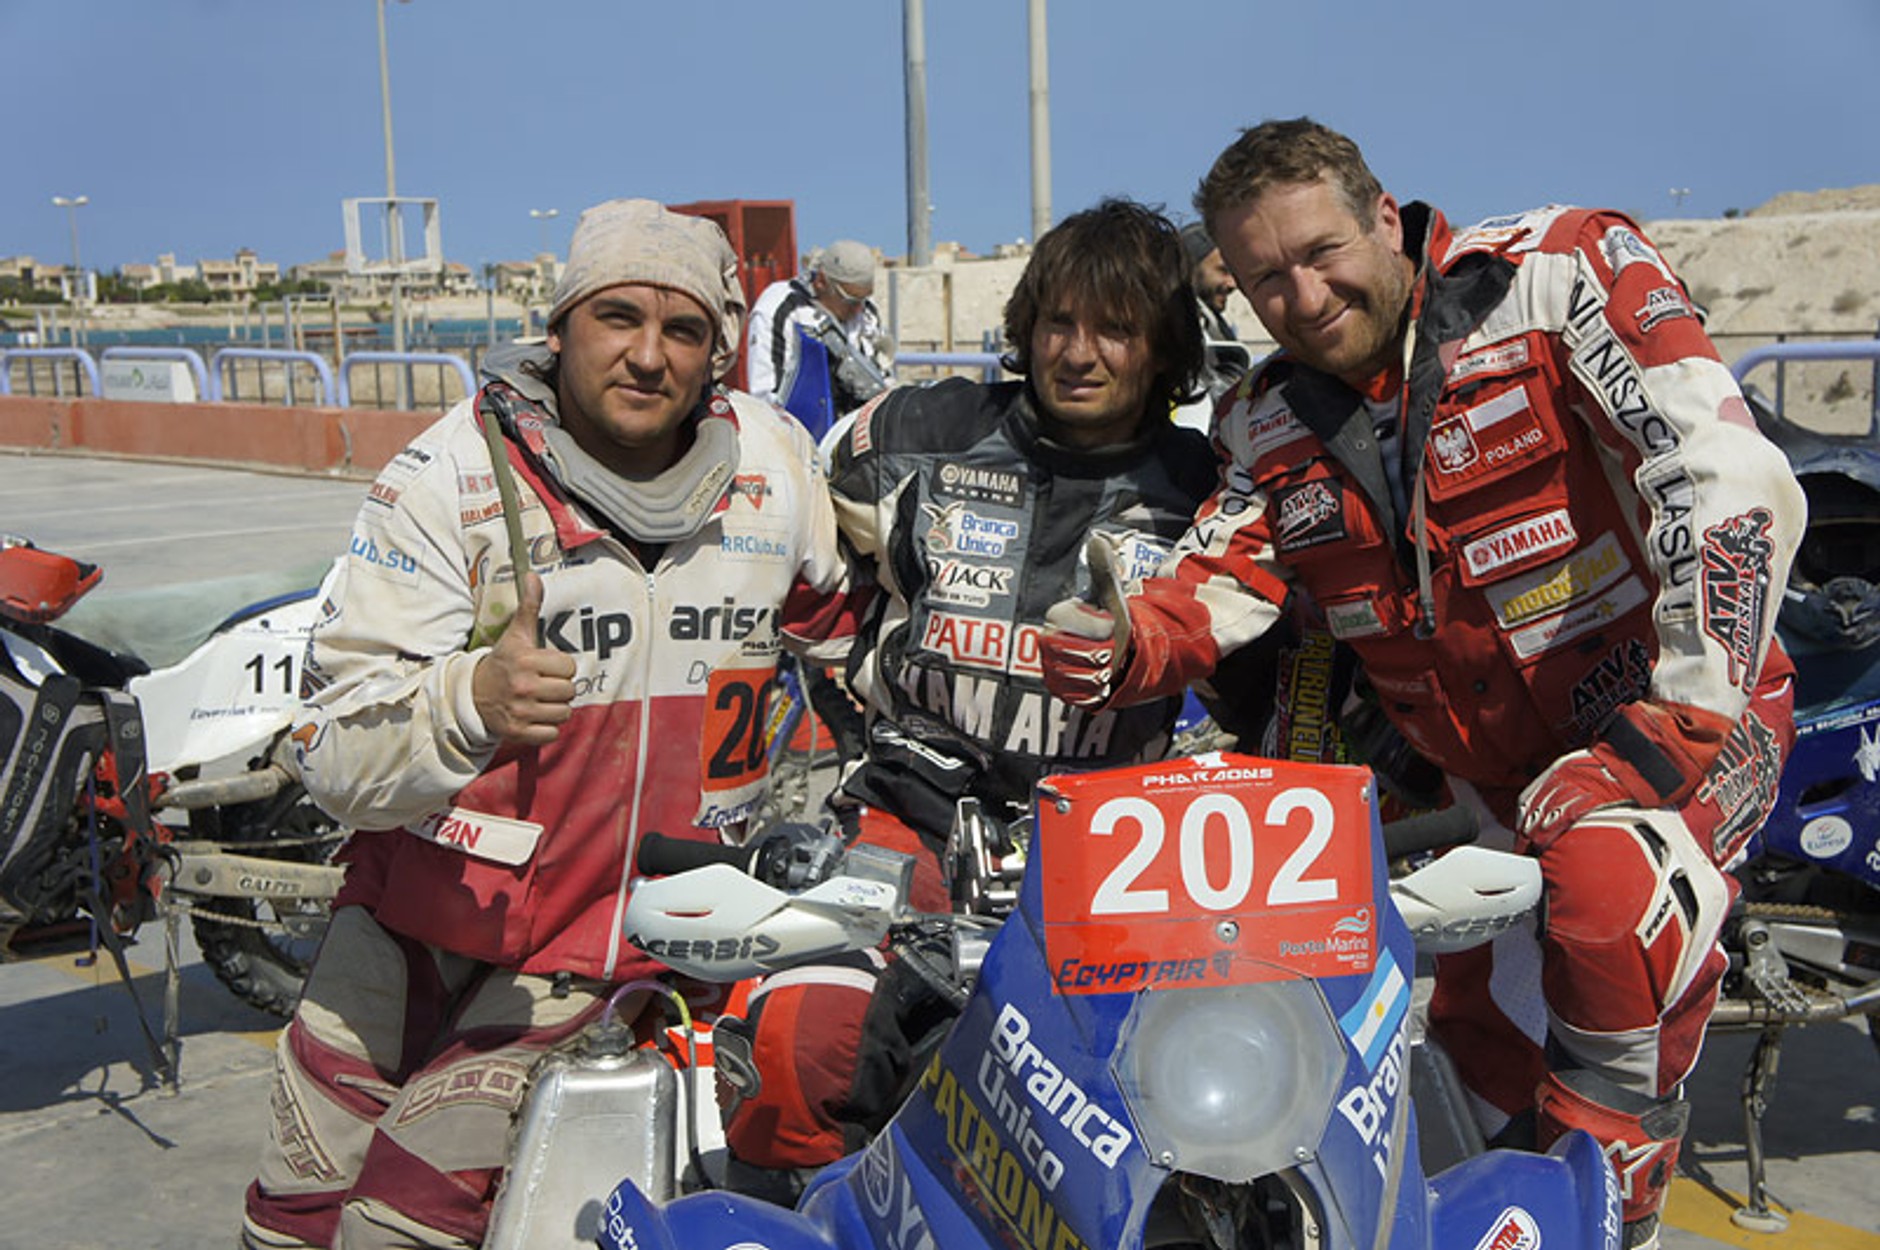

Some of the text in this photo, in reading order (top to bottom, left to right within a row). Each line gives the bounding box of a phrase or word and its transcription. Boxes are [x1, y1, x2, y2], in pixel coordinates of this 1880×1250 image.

[1485, 428, 1544, 464] POLAND
[959, 468, 1020, 495] YAMAHA
[961, 513, 1017, 538] Branca
[1490, 517, 1569, 561] YAMAHA
[899, 663, 1118, 757] YAMAHA
[1143, 767, 1273, 787] PHARAONS
[1089, 787, 1339, 915] 202
[1057, 957, 1205, 987] EGYPTAIR
[990, 1003, 1132, 1169] Branca
